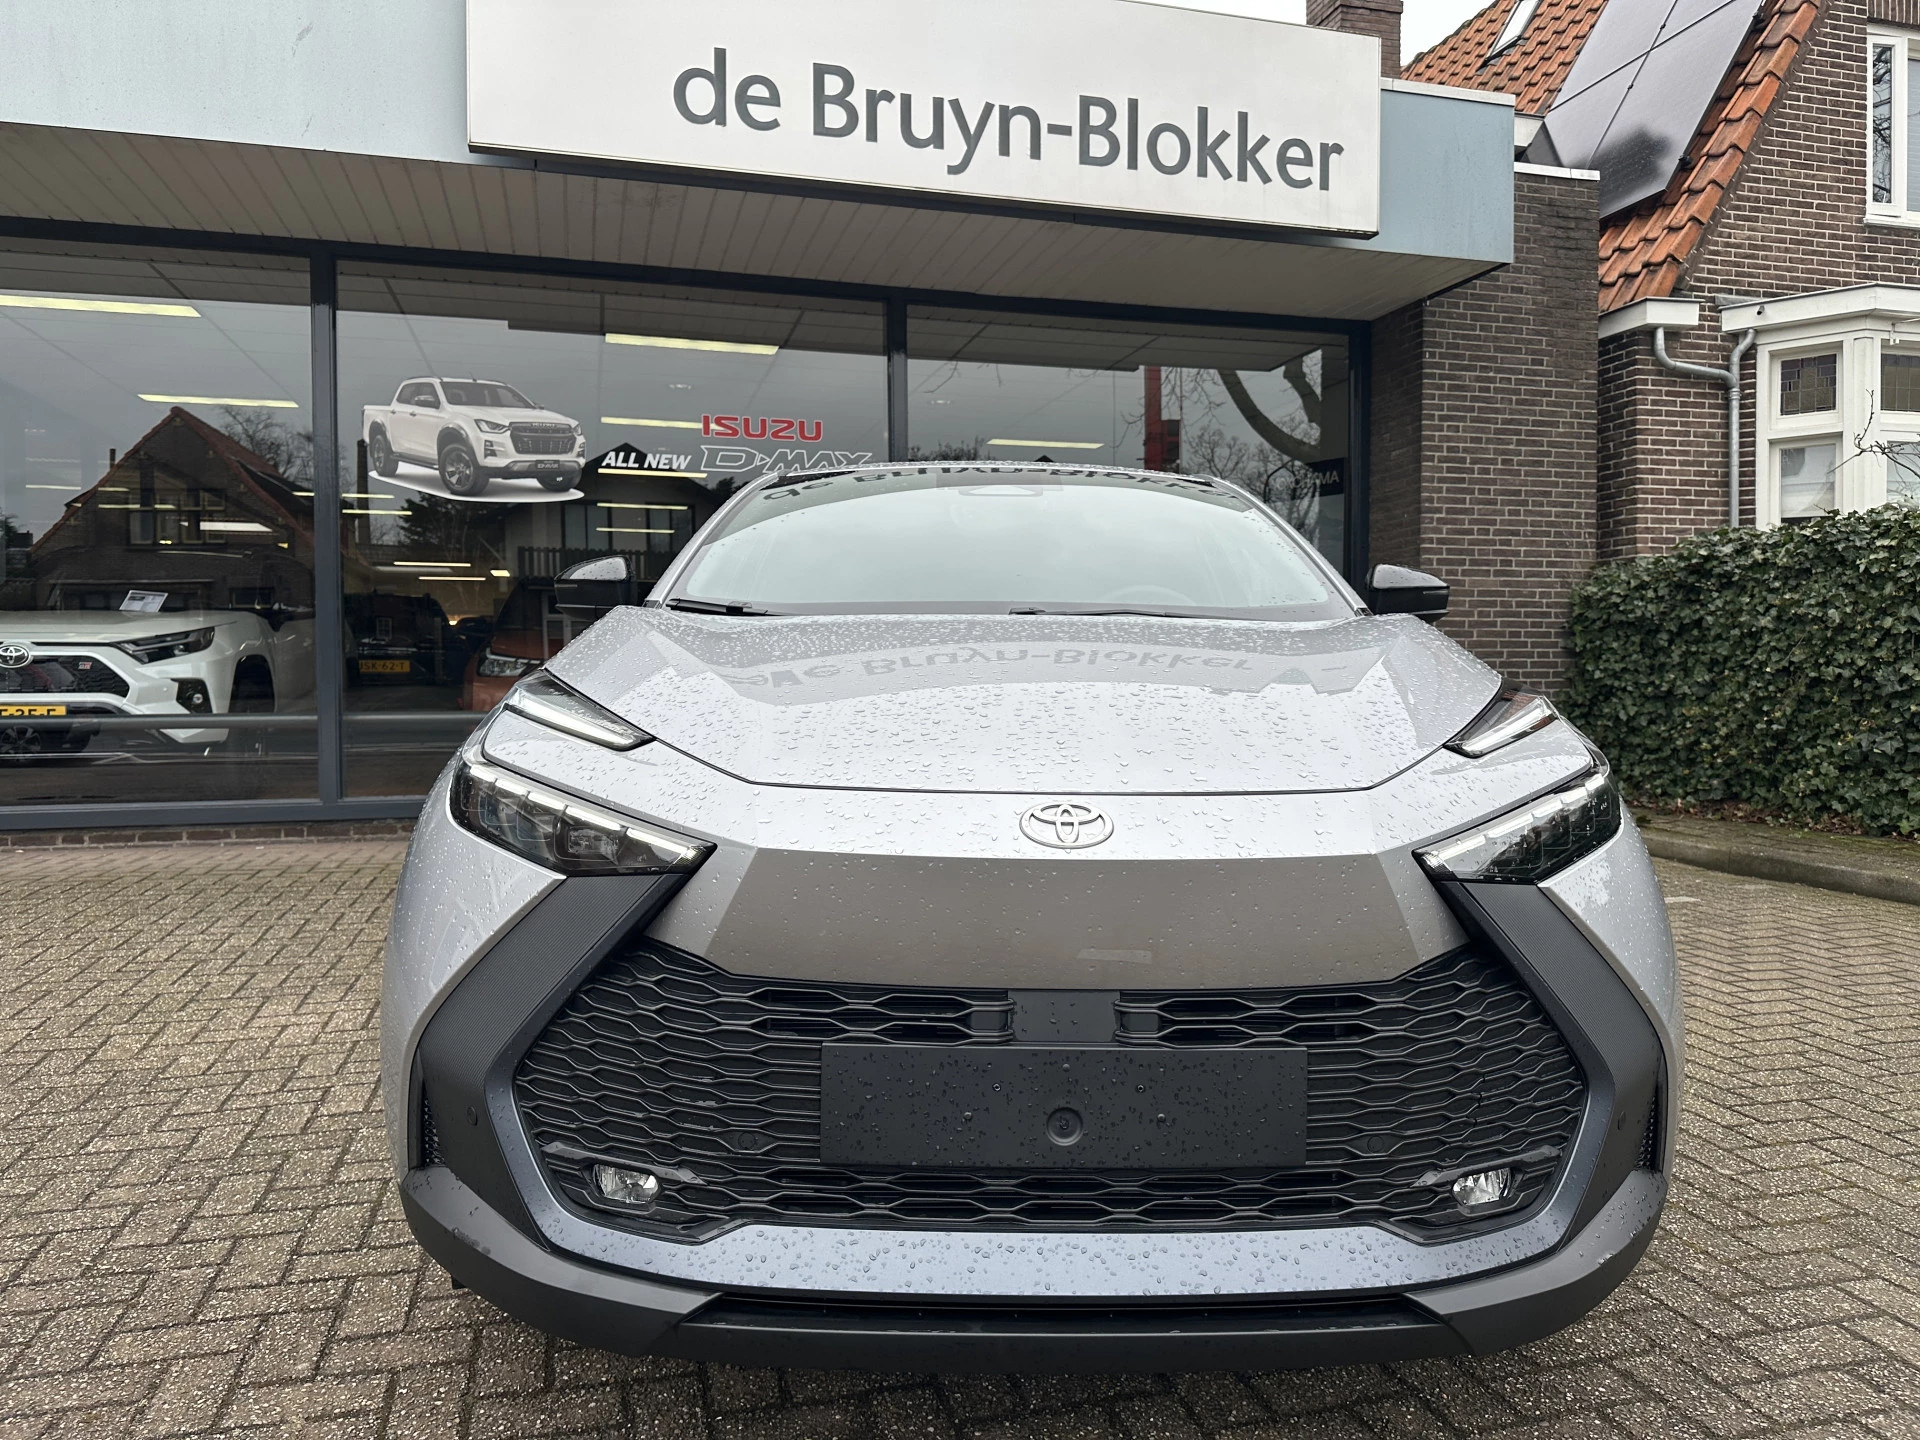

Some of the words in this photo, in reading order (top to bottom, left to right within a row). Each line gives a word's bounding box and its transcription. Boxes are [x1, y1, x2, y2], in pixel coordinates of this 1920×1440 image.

[673, 47, 781, 132] de
[812, 62, 1344, 191] Bruyn-Blokker
[701, 414, 823, 442] ISUZU
[602, 451, 639, 469] ALL
[644, 453, 691, 470] NEW
